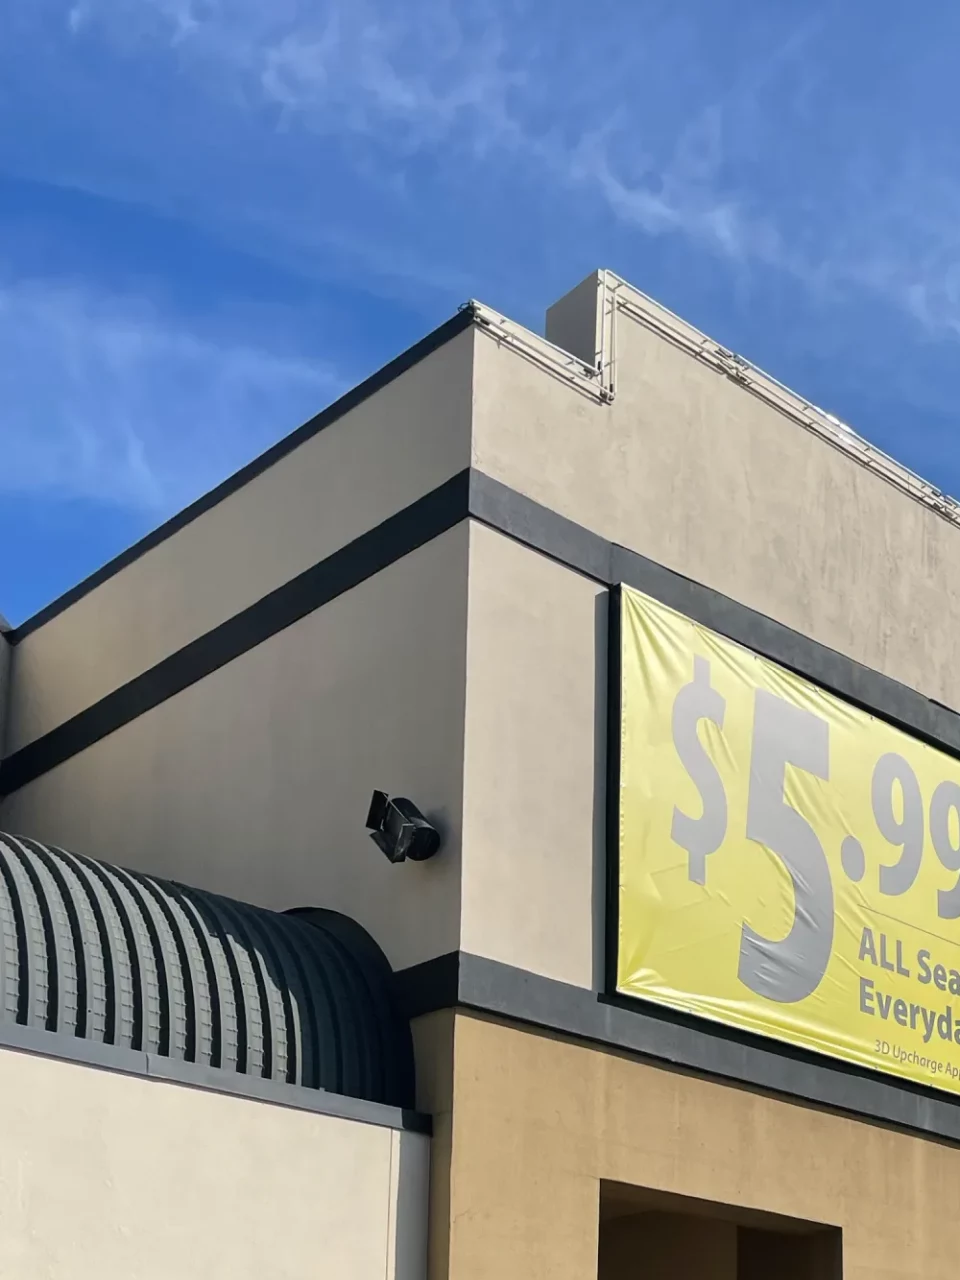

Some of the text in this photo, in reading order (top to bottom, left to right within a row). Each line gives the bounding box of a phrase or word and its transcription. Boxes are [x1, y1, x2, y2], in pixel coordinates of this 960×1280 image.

[858, 926, 910, 978] ALL
[874, 1039, 890, 1055] 3D
[892, 1042, 943, 1073] Upcharge
